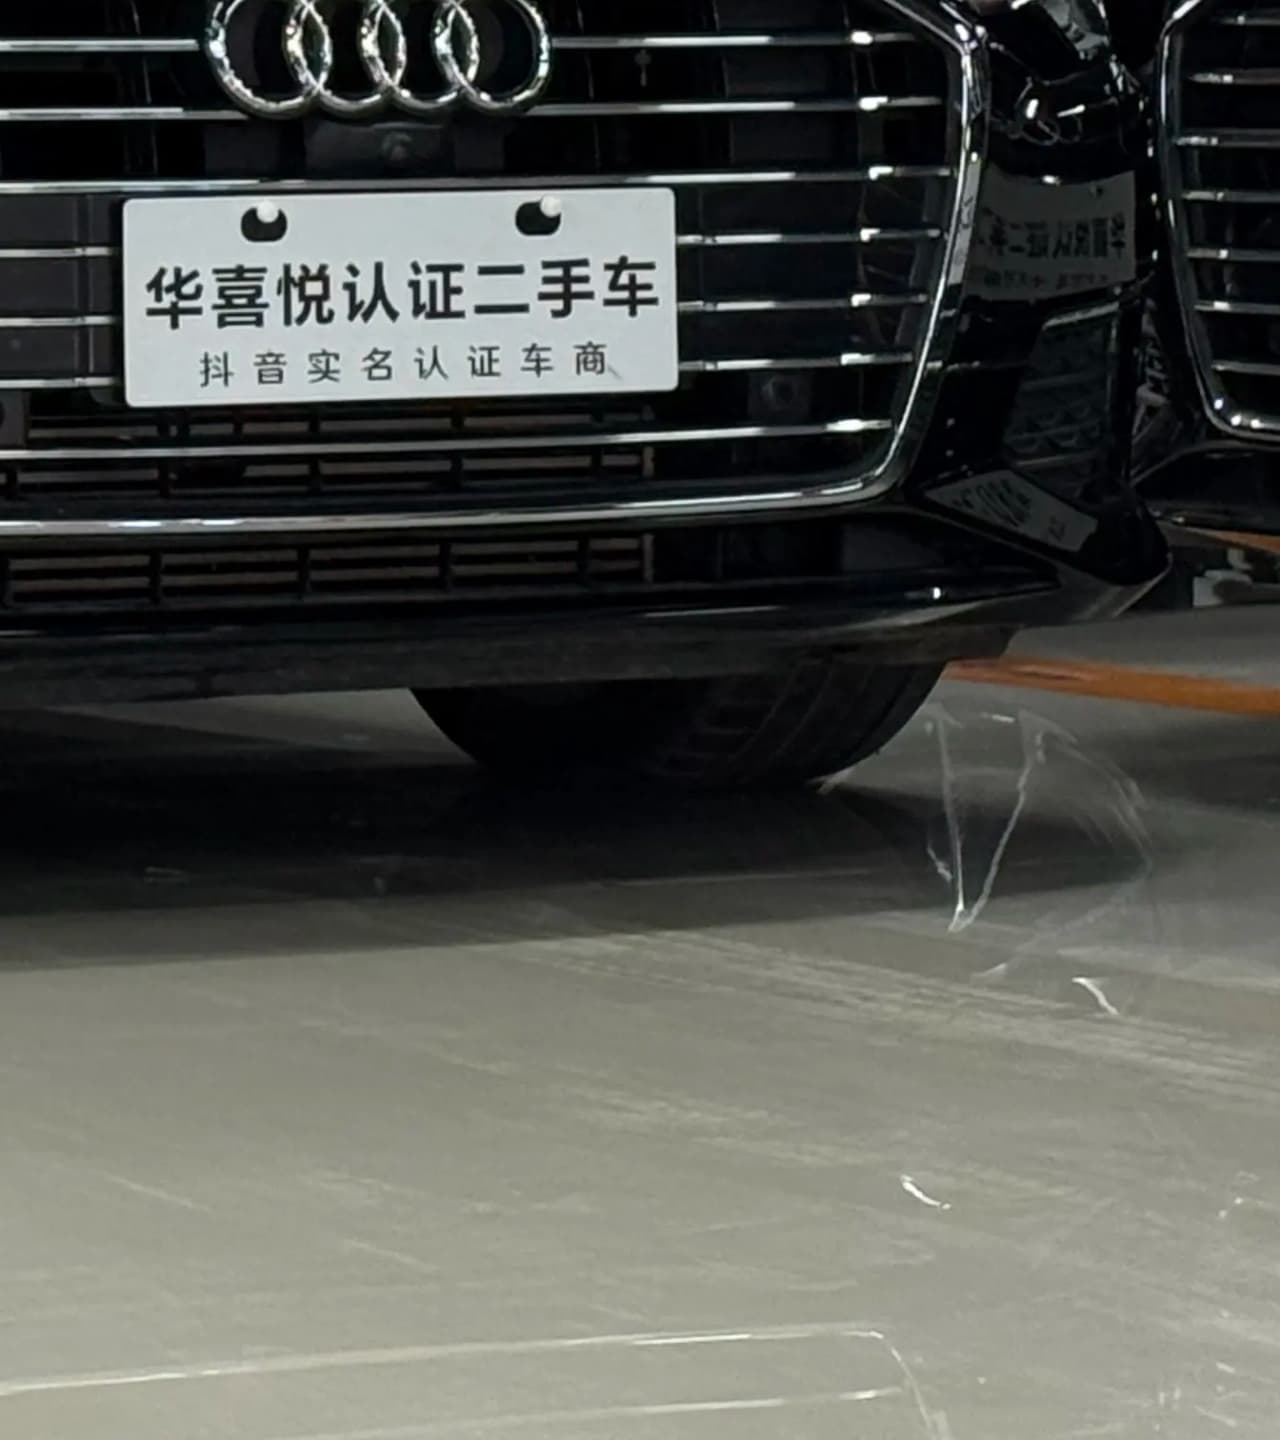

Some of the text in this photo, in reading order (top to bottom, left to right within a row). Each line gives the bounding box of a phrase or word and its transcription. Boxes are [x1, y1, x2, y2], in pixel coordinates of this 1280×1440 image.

[143, 254, 661, 330] 华喜悦认证二手车
[198, 340, 610, 388] 抖音实名认证车商
